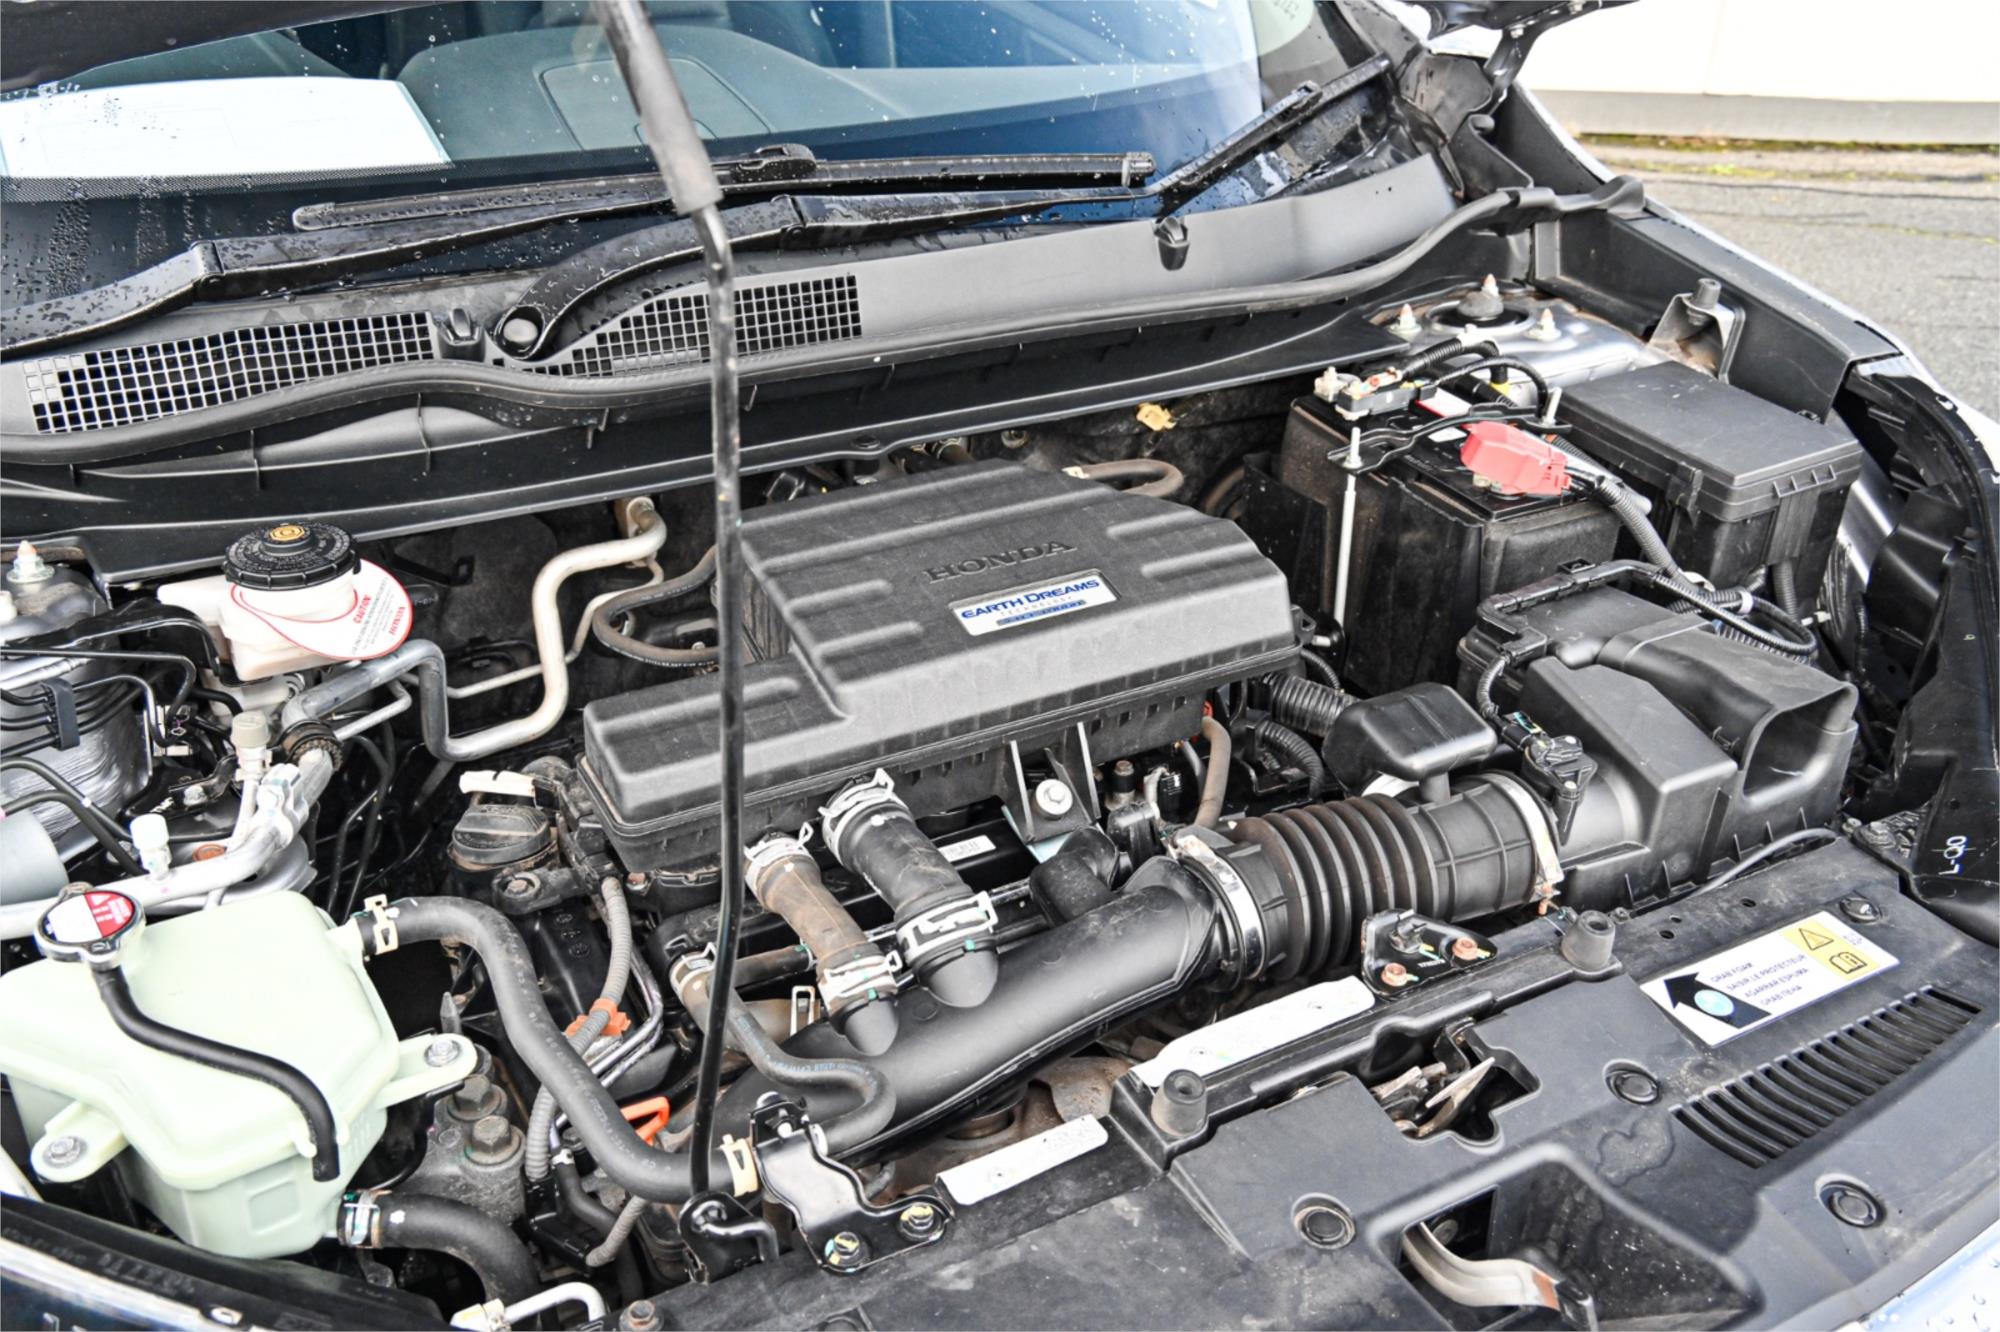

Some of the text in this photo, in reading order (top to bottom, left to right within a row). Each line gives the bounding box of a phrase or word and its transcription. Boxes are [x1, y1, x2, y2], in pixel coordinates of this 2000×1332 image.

[922, 540, 1078, 584] HONDA
[352, 594, 372, 624] CAUTION
[961, 598, 1023, 619] EARTH
[1023, 579, 1100, 603] DREAMS
